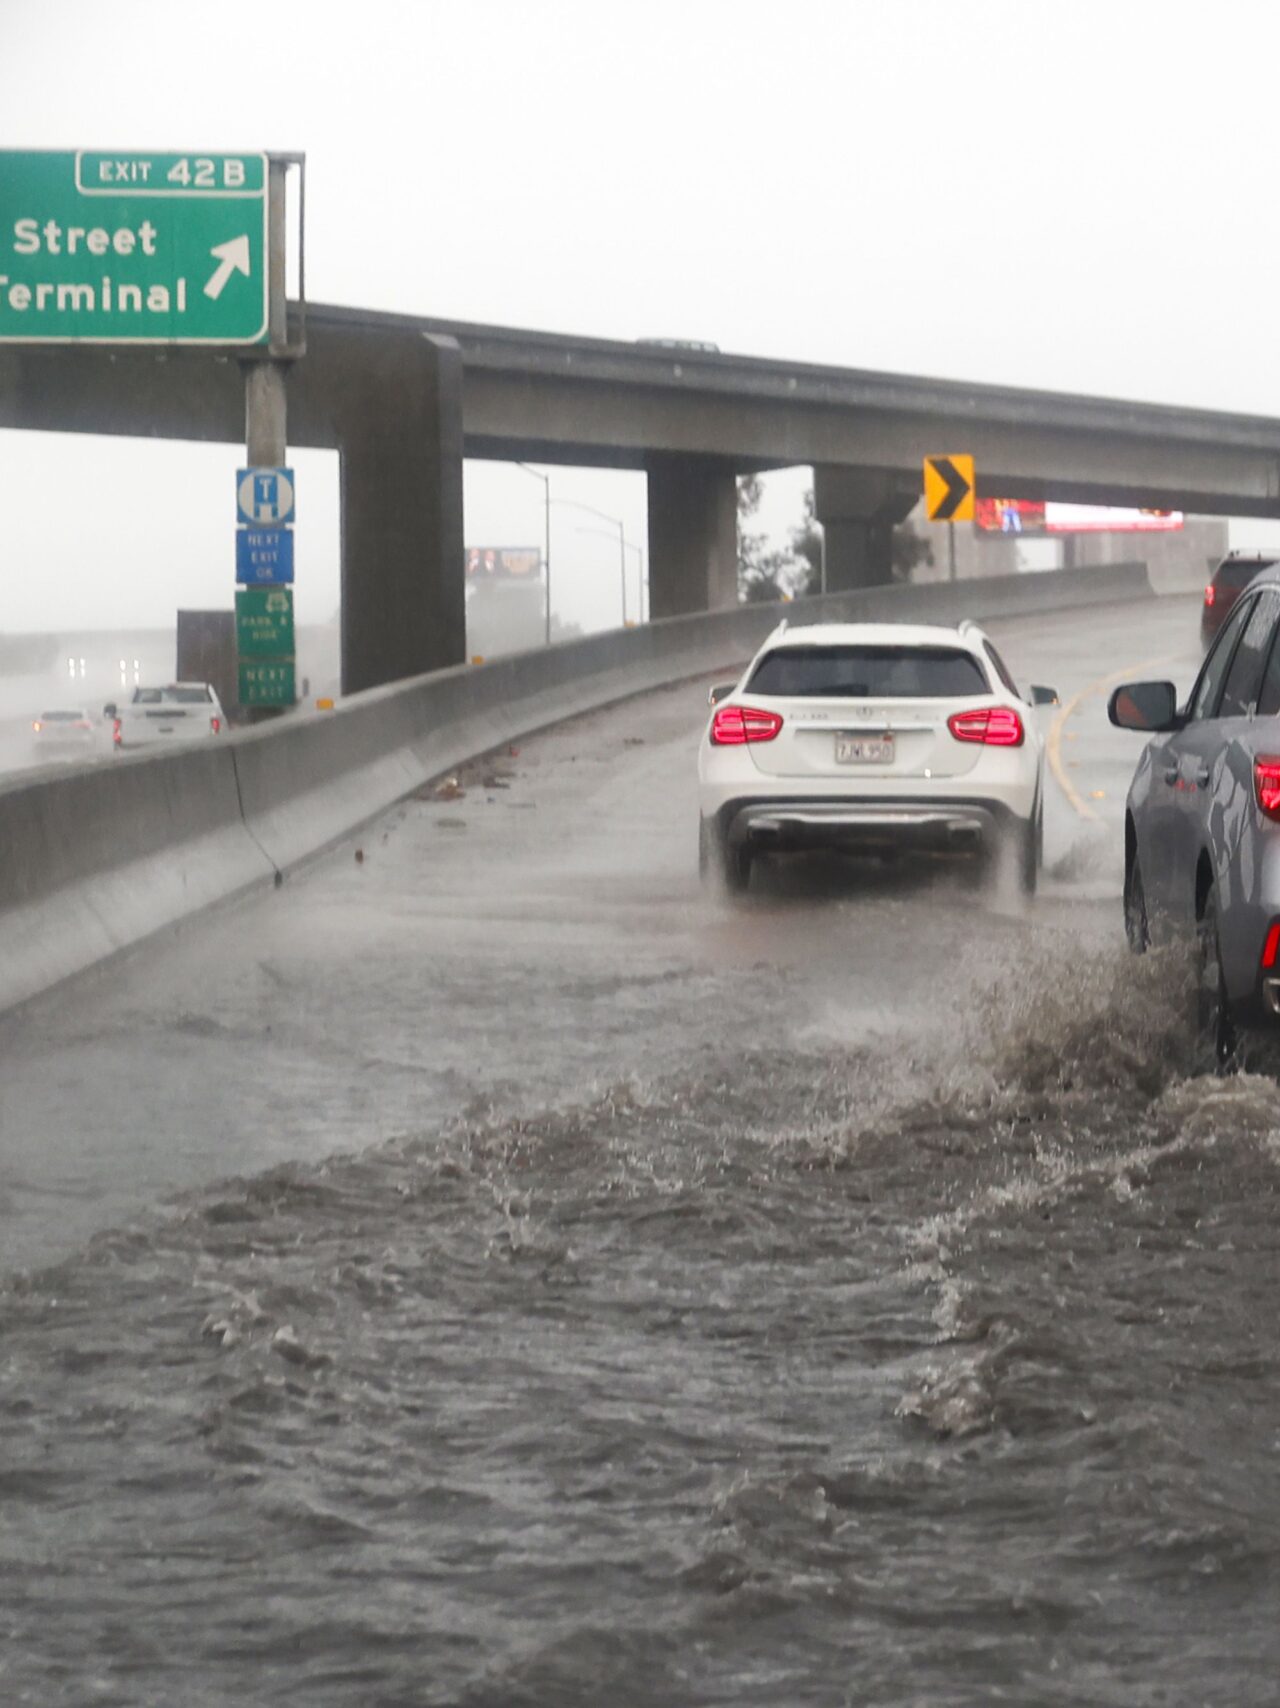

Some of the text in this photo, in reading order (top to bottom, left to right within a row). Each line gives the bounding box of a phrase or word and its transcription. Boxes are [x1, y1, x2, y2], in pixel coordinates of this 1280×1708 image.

[99, 159, 246, 187] EXIT 42B
[13, 218, 157, 255] Street
[0, 275, 187, 312] erminal
